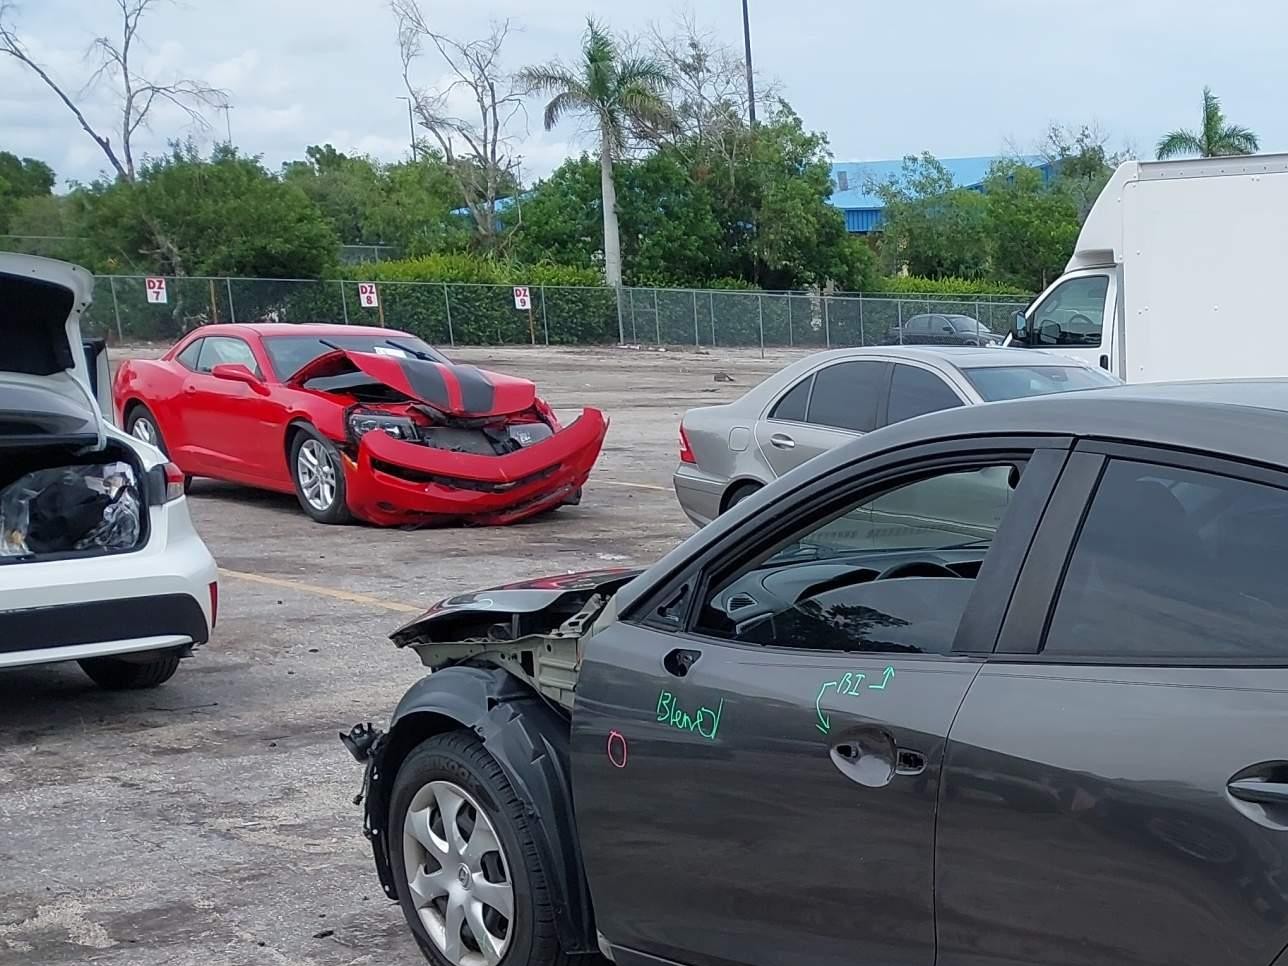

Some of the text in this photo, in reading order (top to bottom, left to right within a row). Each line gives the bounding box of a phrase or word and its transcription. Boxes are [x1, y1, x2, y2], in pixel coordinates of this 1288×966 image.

[147, 279, 165, 290] DZ
[360, 285, 375, 295] DZ
[515, 288, 528, 298] DZ
[152, 291, 161, 301] 7
[366, 295, 373, 305] 8
[519, 298, 527, 307] 9
